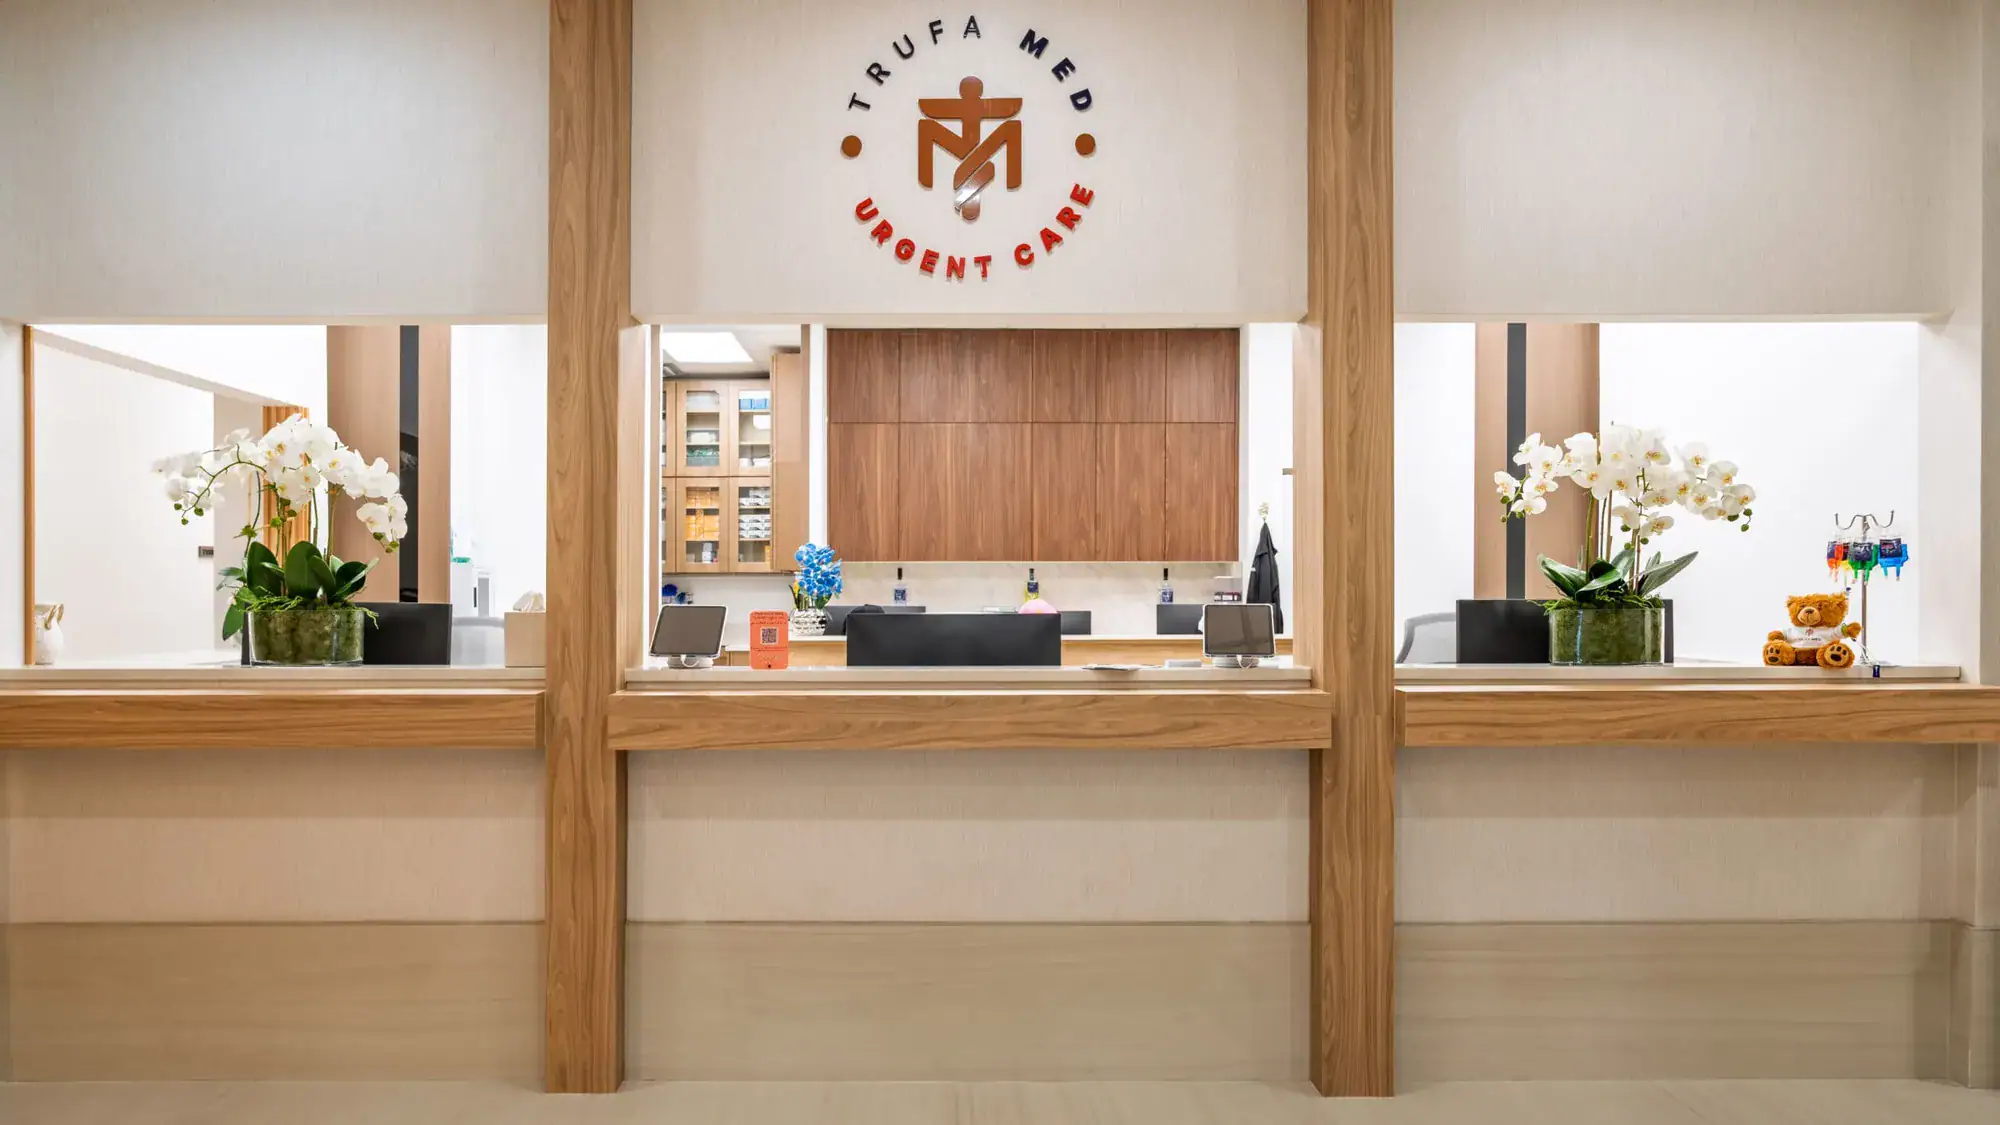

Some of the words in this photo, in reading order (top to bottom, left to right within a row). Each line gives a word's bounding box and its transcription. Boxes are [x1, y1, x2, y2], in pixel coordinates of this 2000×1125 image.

[848, 15, 981, 110] TRUFA
[1019, 28, 1093, 111] MED
[855, 197, 992, 280] URGENT
[1014, 183, 1094, 266] CARE
